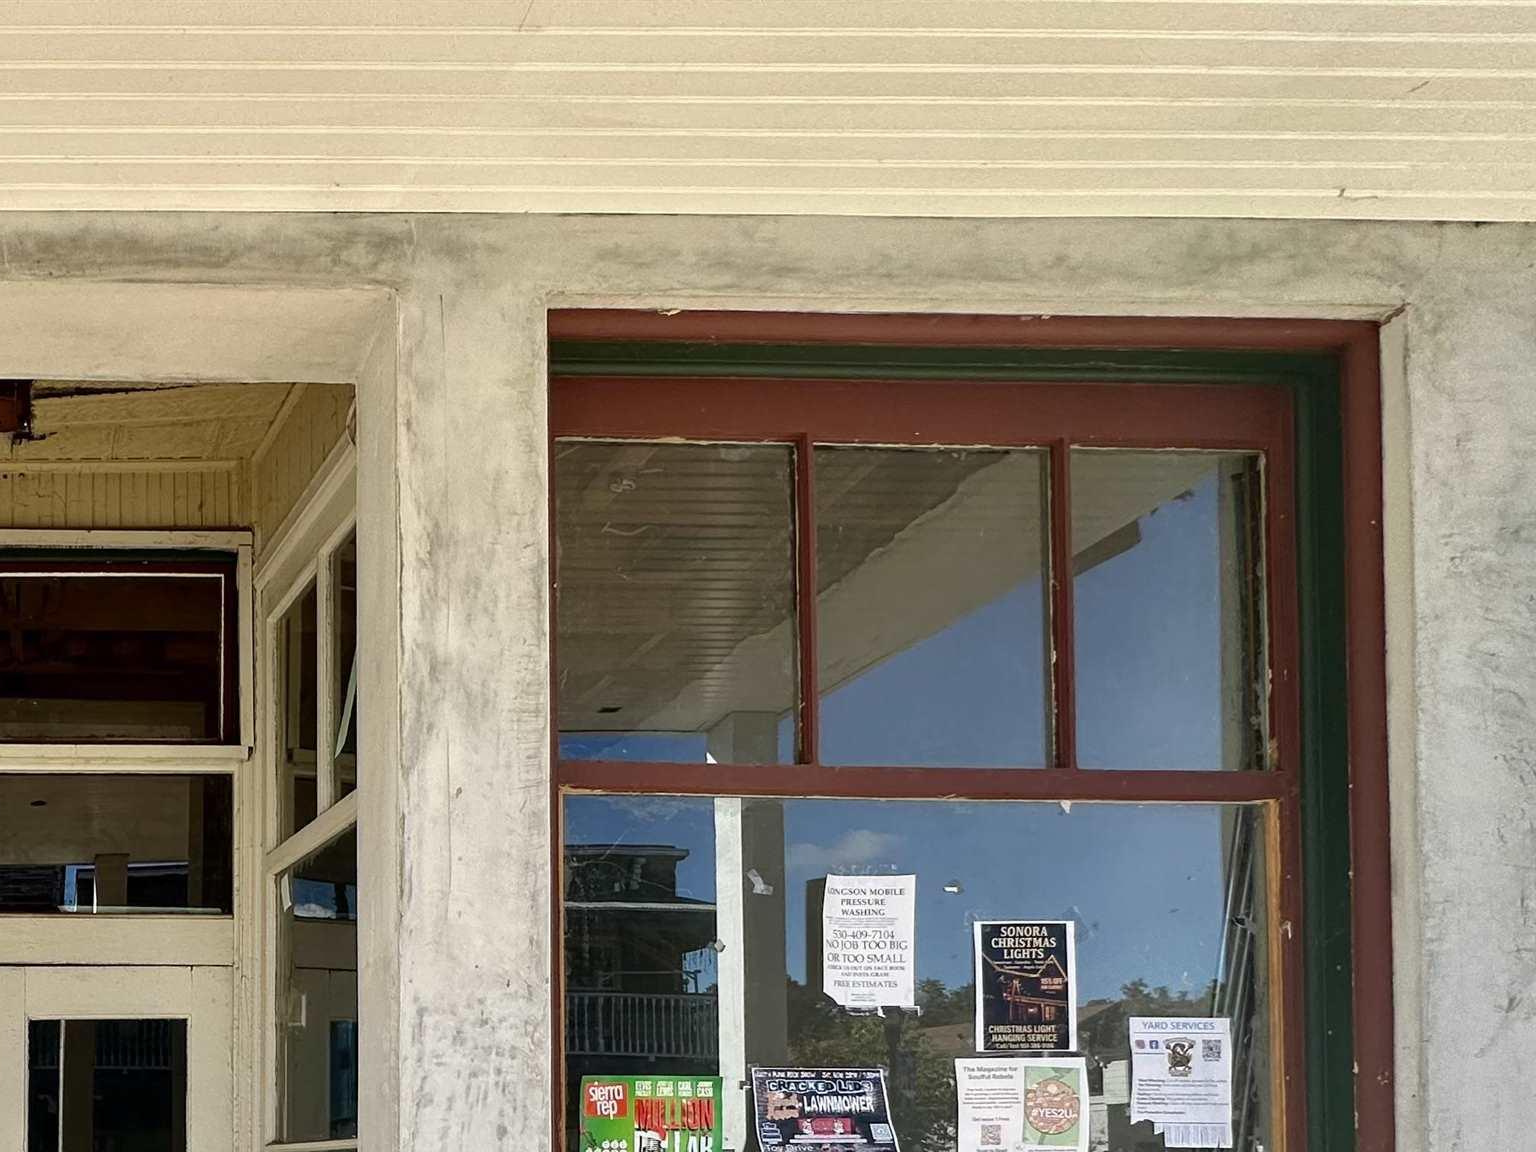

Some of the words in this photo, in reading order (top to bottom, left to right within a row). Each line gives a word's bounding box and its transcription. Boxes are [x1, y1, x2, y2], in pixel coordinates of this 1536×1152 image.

[869, 888, 905, 896] MOBILE
[841, 898, 886, 906] PRESSURE
[841, 908, 886, 916] WASHING
[1000, 926, 1048, 937] SONORA
[841, 940, 859, 951] JOB
[863, 940, 887, 950] TOO
[889, 941, 908, 950] BIG
[991, 937, 1057, 948] CHRISTMAS
[827, 952, 840, 962] OR
[843, 953, 864, 963] TOO
[867, 954, 906, 963] SMALL
[1004, 948, 1045, 959] LIGHTS
[834, 980, 851, 988] FREE
[852, 980, 898, 988] ESTIMATES
[988, 1025, 1032, 1033] CHRISTMAS
[1034, 1025, 1056, 1033] LIGHT
[1142, 1022, 1168, 1030] YARD
[1171, 1022, 1215, 1030] SERVICES
[1027, 1034, 1057, 1042] SERVICE
[590, 1082, 623, 1101] sierra
[768, 1080, 836, 1092] CRACKED
[597, 1100, 617, 1119] rep
[804, 1095, 874, 1113] LAWNMOWER
